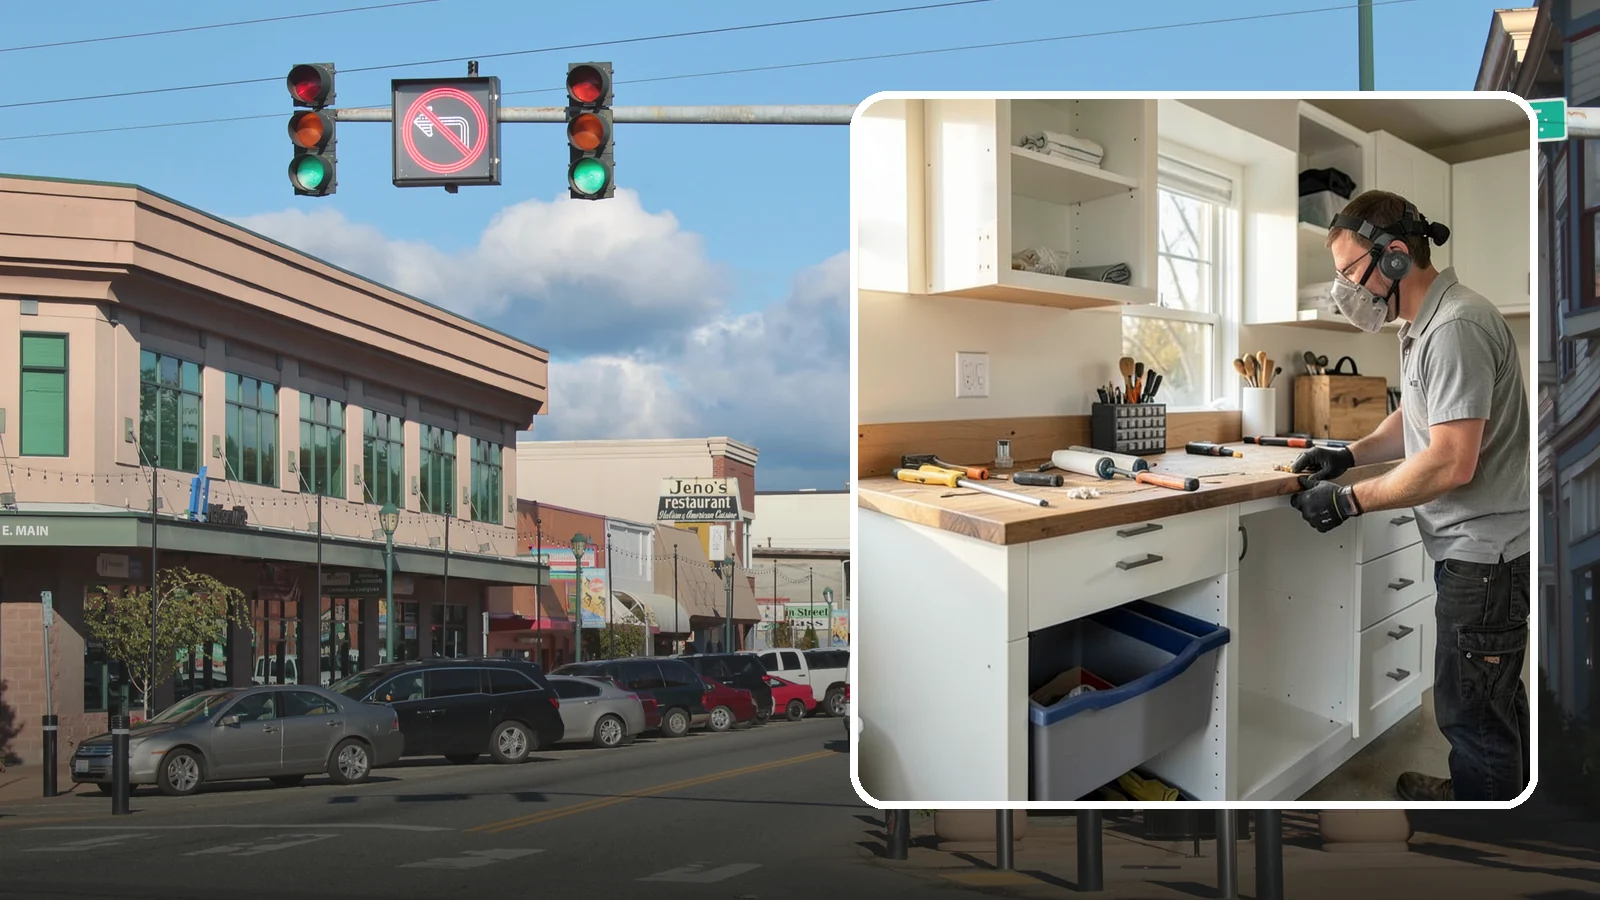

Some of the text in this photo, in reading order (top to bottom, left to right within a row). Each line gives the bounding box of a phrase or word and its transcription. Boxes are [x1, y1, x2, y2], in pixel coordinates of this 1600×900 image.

[669, 480, 728, 494] Jeno's
[665, 497, 731, 509] restaurant
[659, 510, 681, 519] Italian
[686, 510, 714, 519] American
[715, 510, 738, 519] Cuisine
[2, 525, 49, 536] E. MAIN
[797, 608, 829, 617] Street
